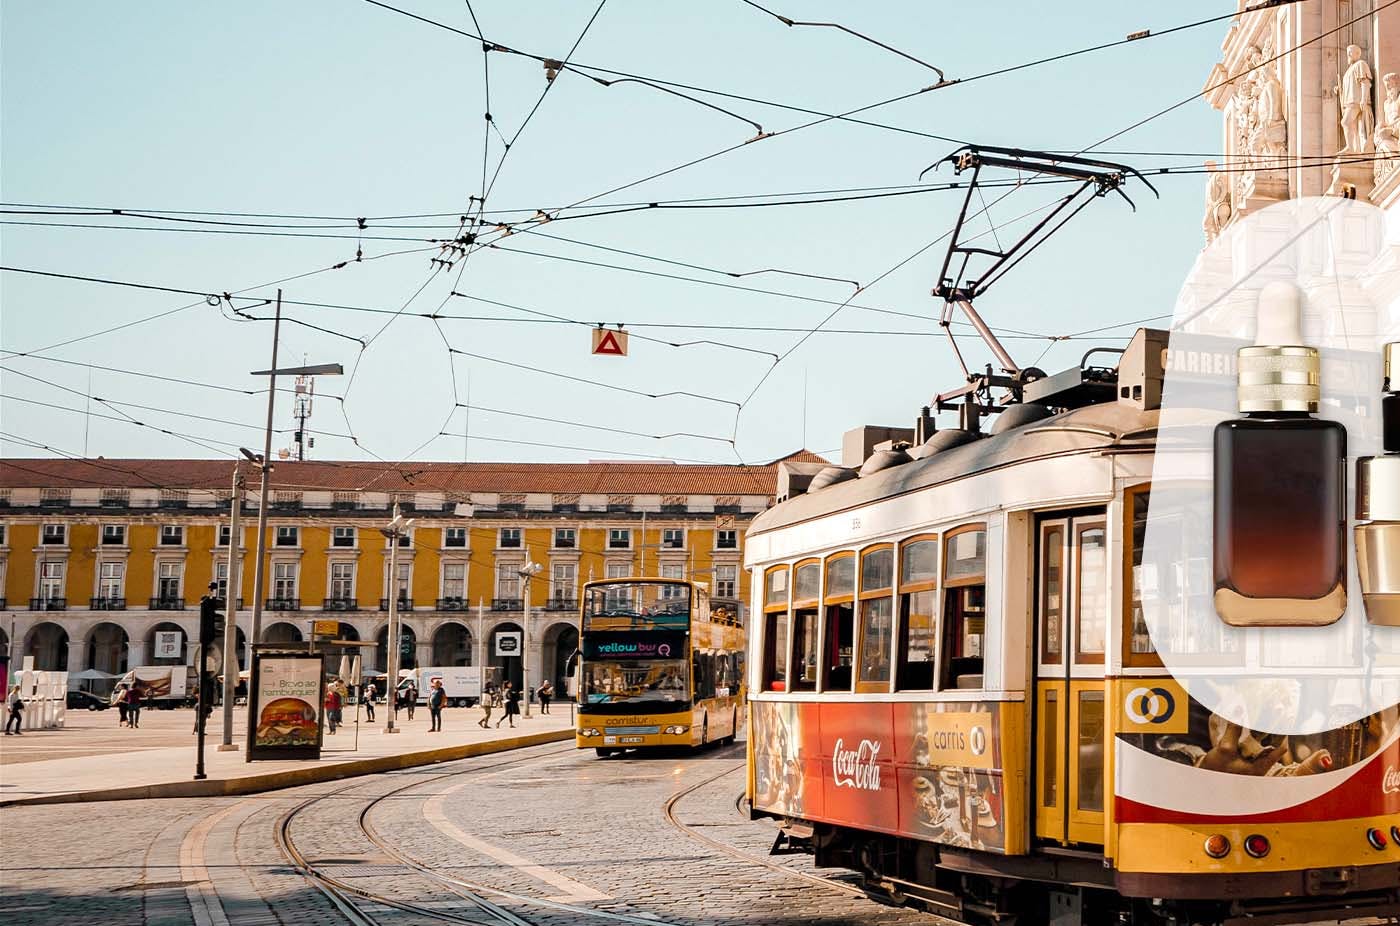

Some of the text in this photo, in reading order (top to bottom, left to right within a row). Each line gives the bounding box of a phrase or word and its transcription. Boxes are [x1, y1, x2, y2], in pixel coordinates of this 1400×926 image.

[1161, 348, 1238, 376] CARREI
[598, 643, 637, 653] yellow
[933, 724, 965, 751] carris
[832, 738, 882, 791] Coca-Cola
